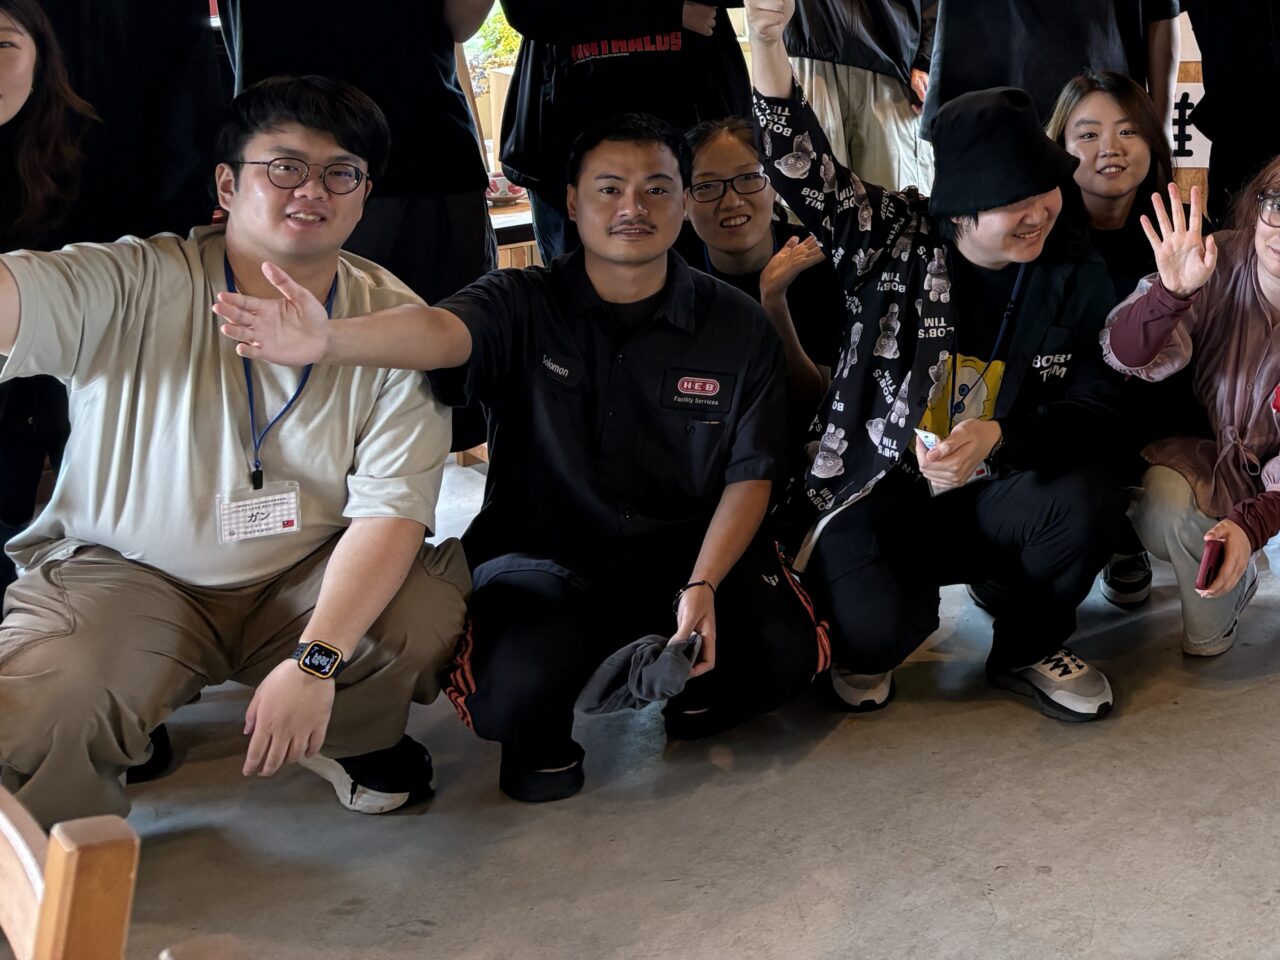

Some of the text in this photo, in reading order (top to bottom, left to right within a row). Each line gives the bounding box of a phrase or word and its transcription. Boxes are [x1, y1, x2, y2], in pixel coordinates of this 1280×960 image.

[924, 317, 947, 327] TIM
[542, 353, 569, 377] Solomon
[673, 395, 719, 405] Facility Services
[247, 511, 271, 523] ガン
